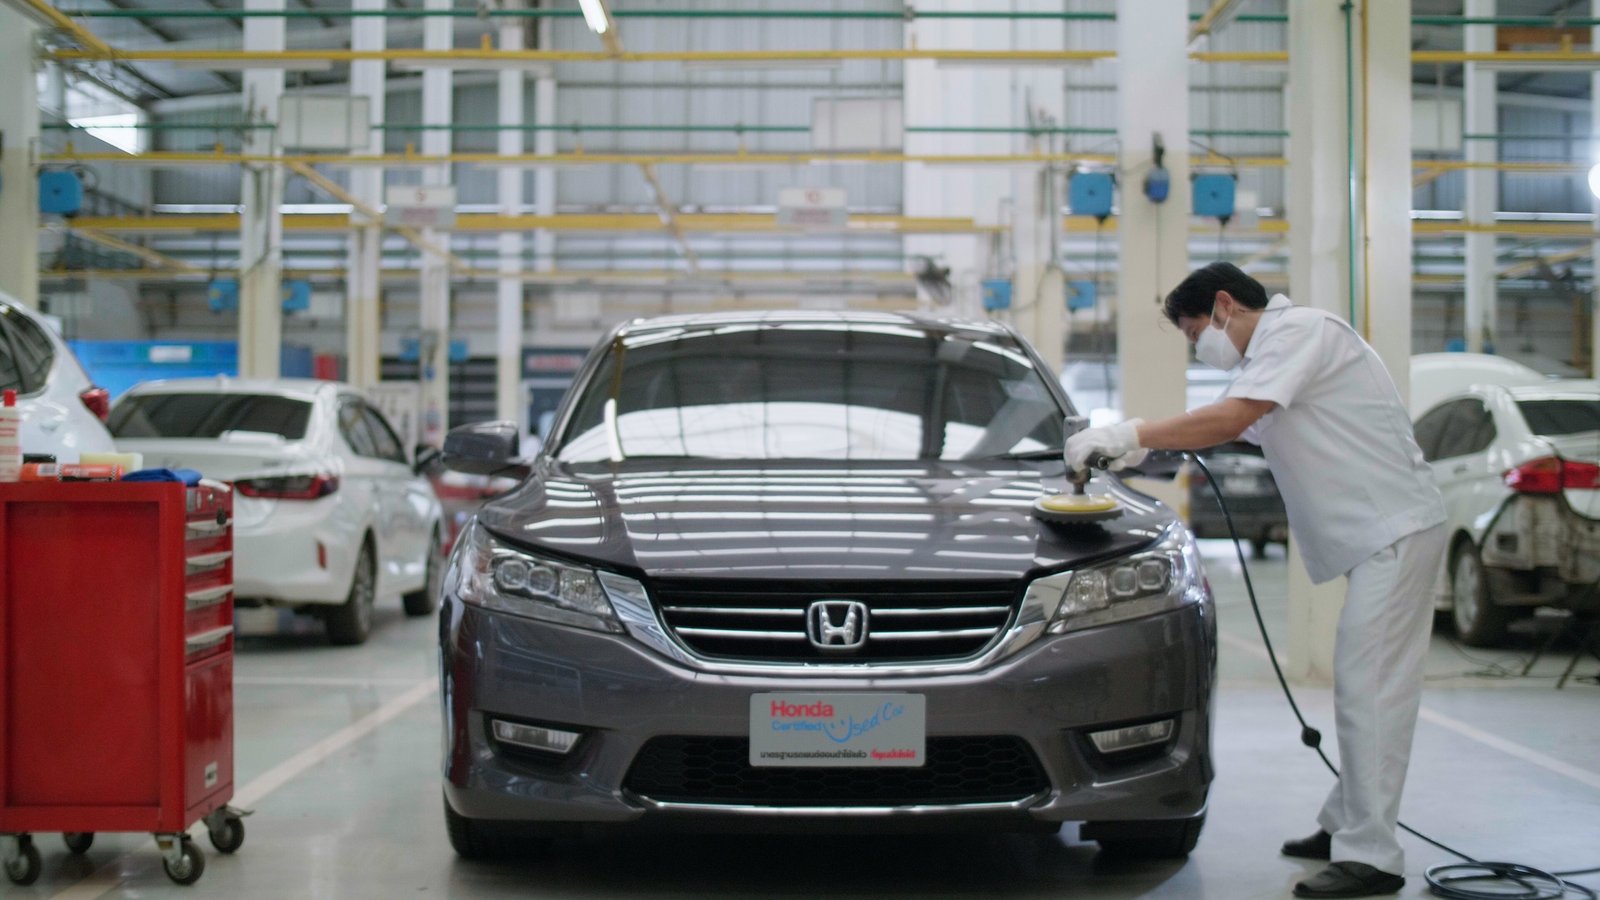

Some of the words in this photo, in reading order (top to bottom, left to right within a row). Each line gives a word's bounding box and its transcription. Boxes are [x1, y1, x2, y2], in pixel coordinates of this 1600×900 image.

[771, 700, 834, 718] Honda
[772, 720, 824, 731] Certified
[822, 706, 881, 744] Used
